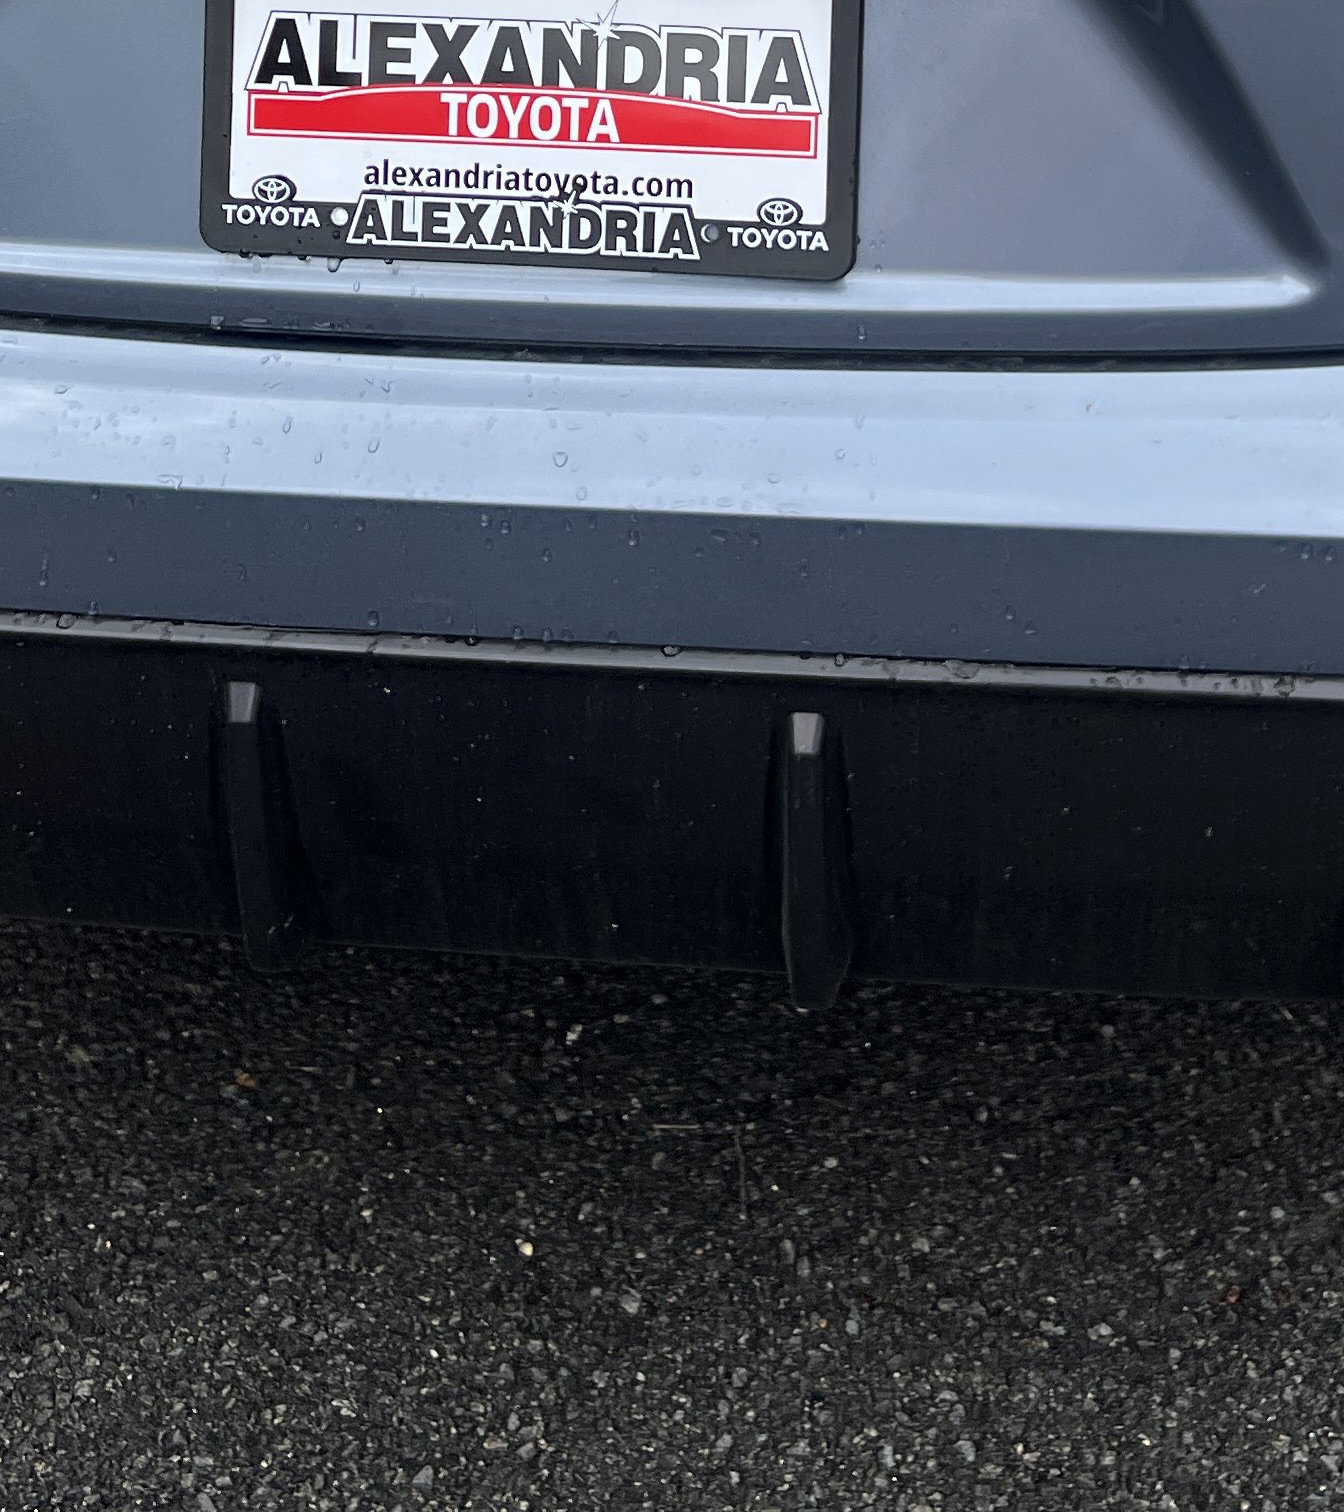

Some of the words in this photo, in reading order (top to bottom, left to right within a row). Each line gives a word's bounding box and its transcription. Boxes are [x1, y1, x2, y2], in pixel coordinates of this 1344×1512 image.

[252, 13, 814, 109] ALEXANDRIA
[441, 93, 619, 144] TOYOTA
[363, 158, 694, 200] alexandriatoyota.com
[222, 203, 320, 228] TOYOTA
[348, 194, 700, 260] ALEXANDRIA
[727, 226, 829, 252] TOYOTA
